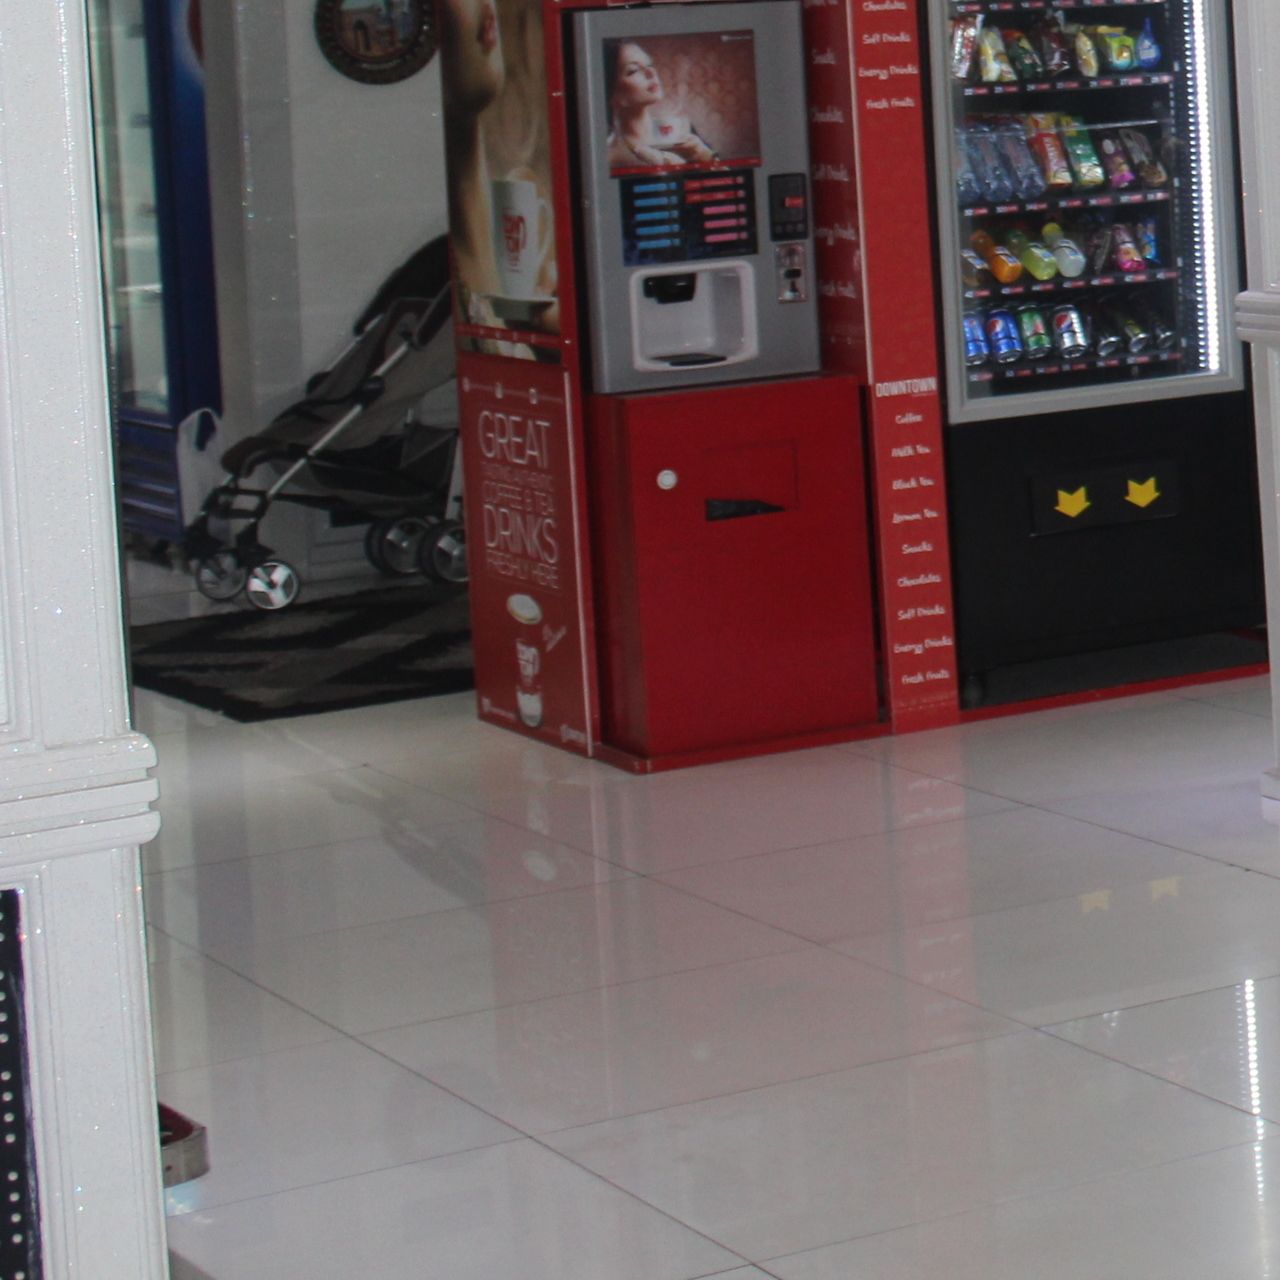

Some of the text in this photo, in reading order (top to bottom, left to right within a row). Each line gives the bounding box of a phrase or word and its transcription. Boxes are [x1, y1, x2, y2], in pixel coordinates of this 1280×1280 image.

[862, 0, 908, 11] Chocolates
[862, 32, 912, 45] Soft Drinks
[858, 64, 919, 80] Energy Drinks
[875, 376, 938, 398] DOWNTOWN
[895, 412, 923, 424] Coffee
[478, 410, 551, 469] GREAT
[892, 478, 918, 490] Black
[483, 504, 560, 564] DRINKS
[902, 541, 934, 554] Snacks
[897, 573, 942, 587] Chocolates
[898, 604, 946, 620] Soft Drinks
[924, 636, 953, 648] Drinks
